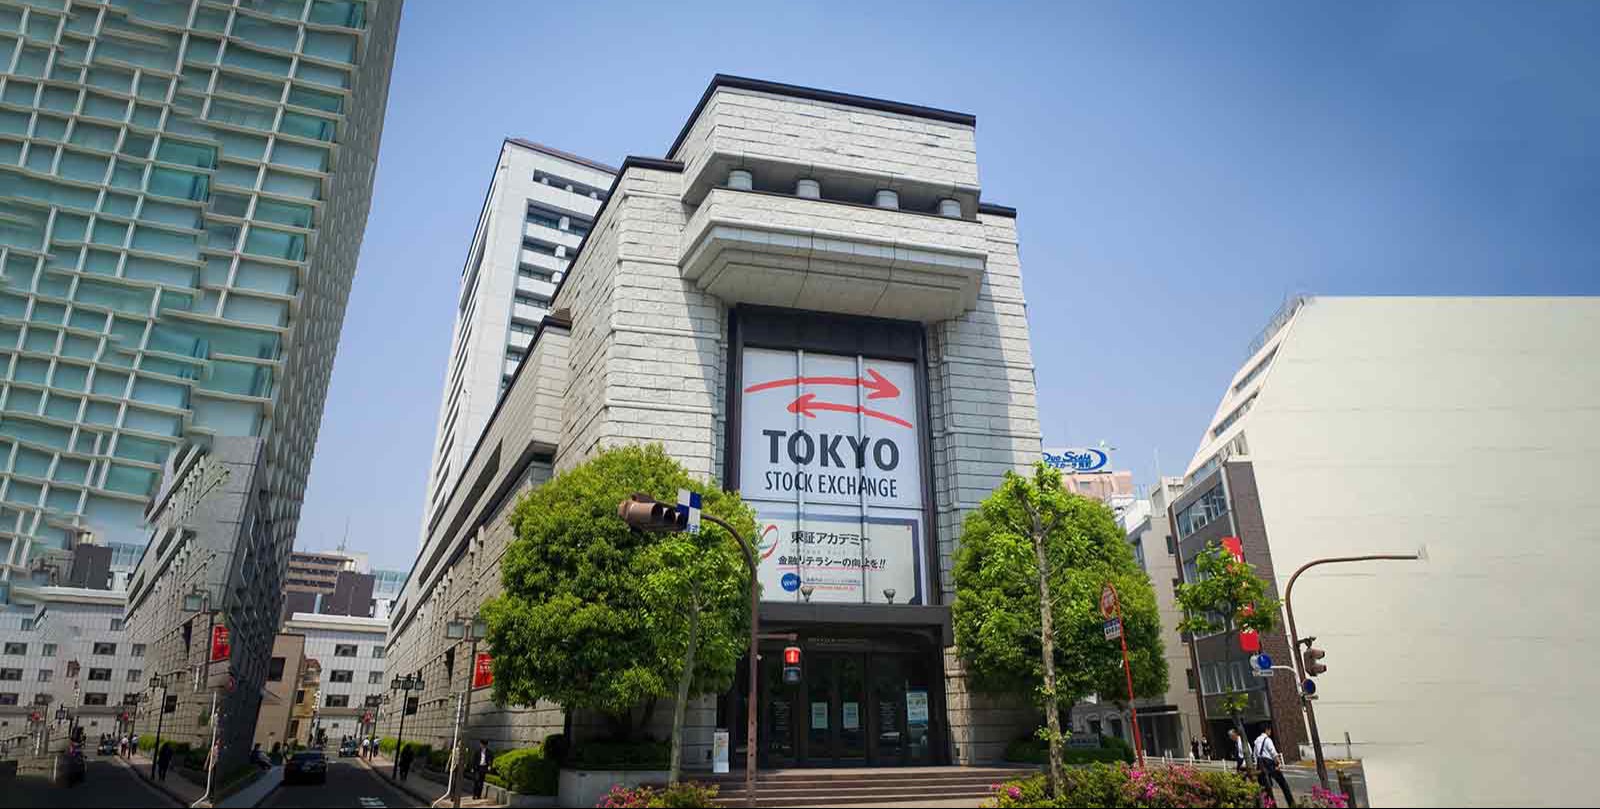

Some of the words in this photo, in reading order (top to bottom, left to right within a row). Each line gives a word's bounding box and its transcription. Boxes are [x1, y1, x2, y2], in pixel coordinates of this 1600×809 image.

[763, 429, 900, 471] TOKYO
[765, 471, 813, 493] STOCK
[818, 474, 898, 498] EXCHANGE
[791, 530, 871, 546] 東証アカデミー
